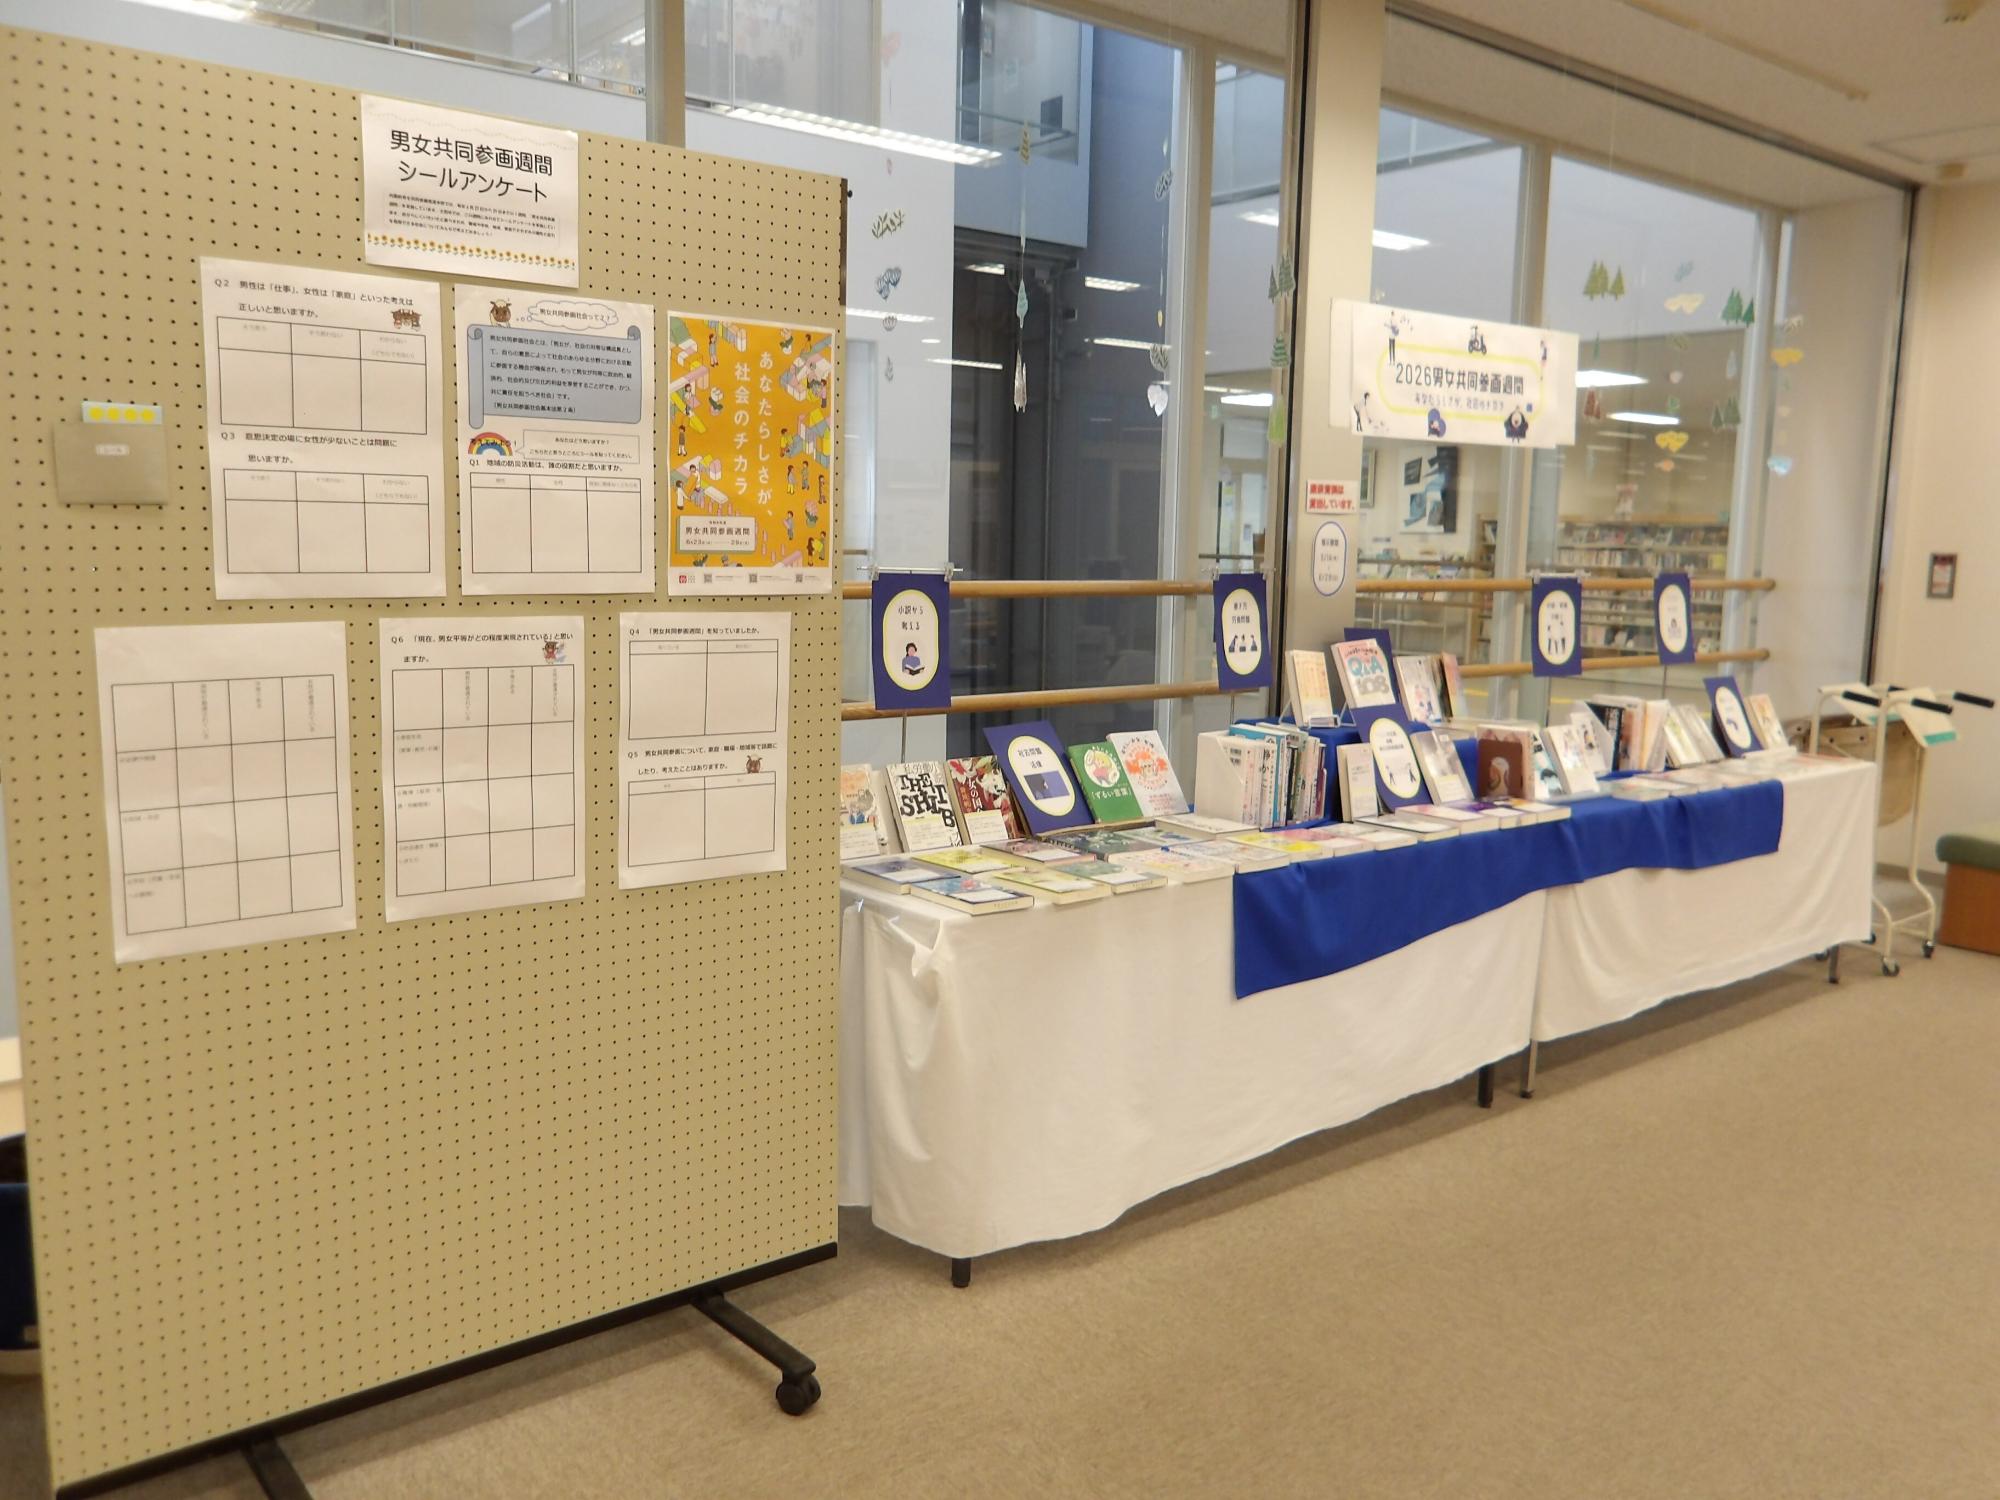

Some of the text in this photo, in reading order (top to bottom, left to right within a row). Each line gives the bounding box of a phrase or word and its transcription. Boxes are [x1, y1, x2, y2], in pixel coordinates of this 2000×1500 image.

[390, 129, 553, 177] 男女共同参画週間
[398, 160, 548, 203] シールアンケート
[1394, 361, 1525, 396] 2026男女共同参画週間
[733, 362, 750, 496] 社会のチカラ
[757, 351, 774, 517] あなたらしさが、
[898, 772, 936, 794] THE
